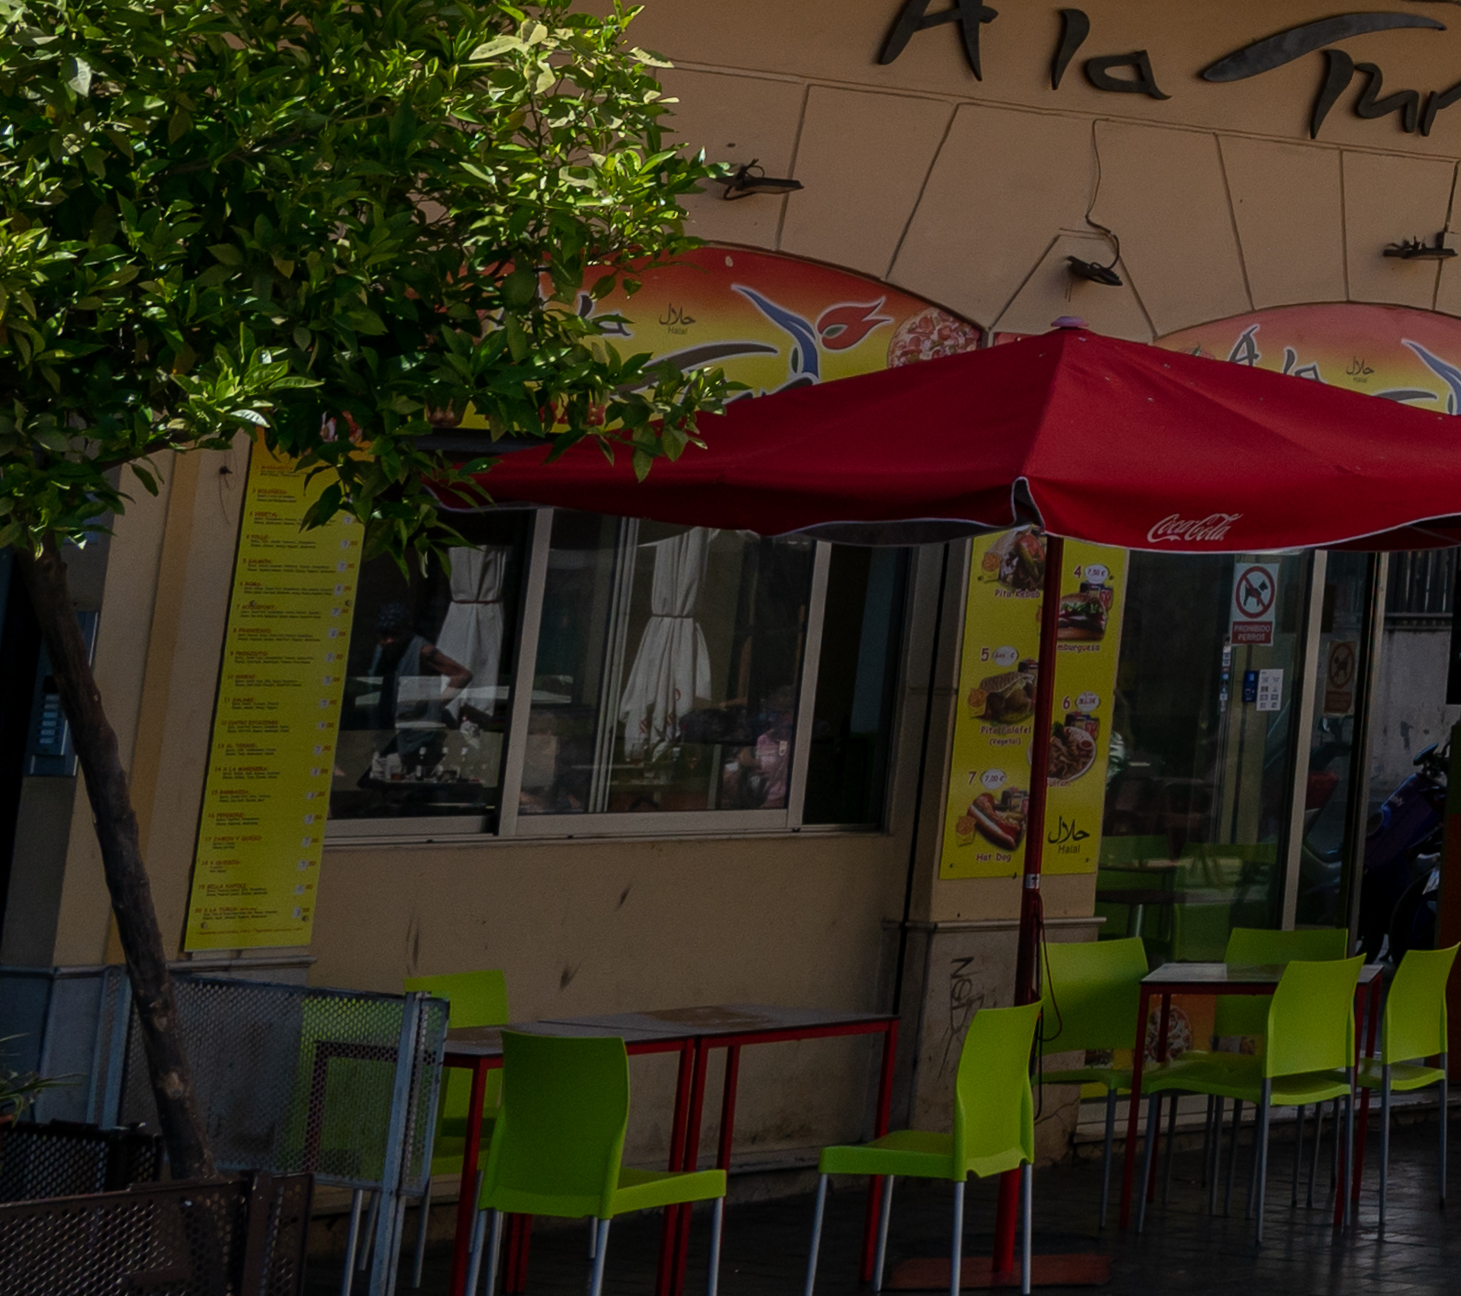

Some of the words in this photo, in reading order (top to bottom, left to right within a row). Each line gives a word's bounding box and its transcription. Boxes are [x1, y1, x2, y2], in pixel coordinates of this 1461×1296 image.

[1052, 8, 1172, 100] la
[1073, 565, 1082, 578] 4
[1014, 588, 1041, 598] Kebab
[1237, 633, 1266, 641] PERROS
[980, 647, 990, 661] 5
[1062, 695, 1071, 709] 6
[968, 770, 977, 785] 7
[1047, 814, 1091, 844] حلال
[1057, 844, 1081, 854] Halal
